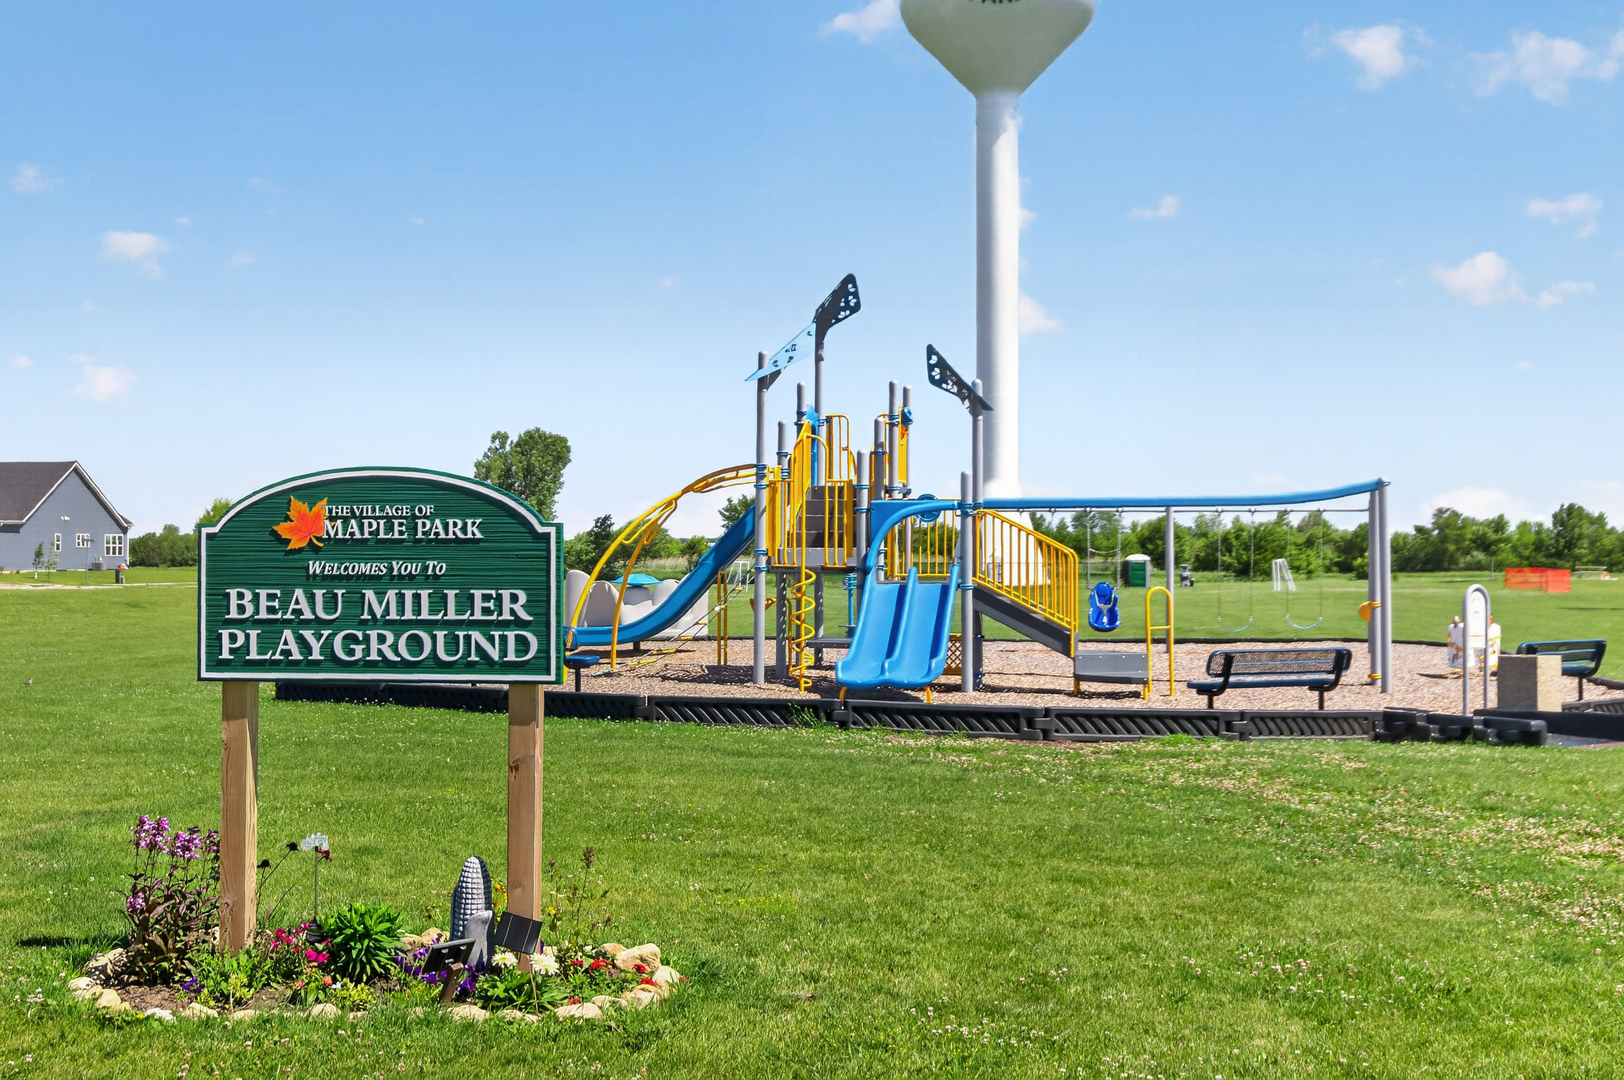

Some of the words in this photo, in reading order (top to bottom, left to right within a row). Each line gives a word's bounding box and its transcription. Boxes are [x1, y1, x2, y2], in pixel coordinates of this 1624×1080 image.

[322, 505, 351, 516] THE
[352, 505, 411, 516] VILLAGE
[414, 504, 434, 516] OF
[322, 519, 408, 539] MAPLE
[415, 518, 484, 539] PARK
[225, 589, 346, 620] BEAU
[360, 589, 534, 621] MILLER
[218, 629, 539, 662] PLAYGROUND
